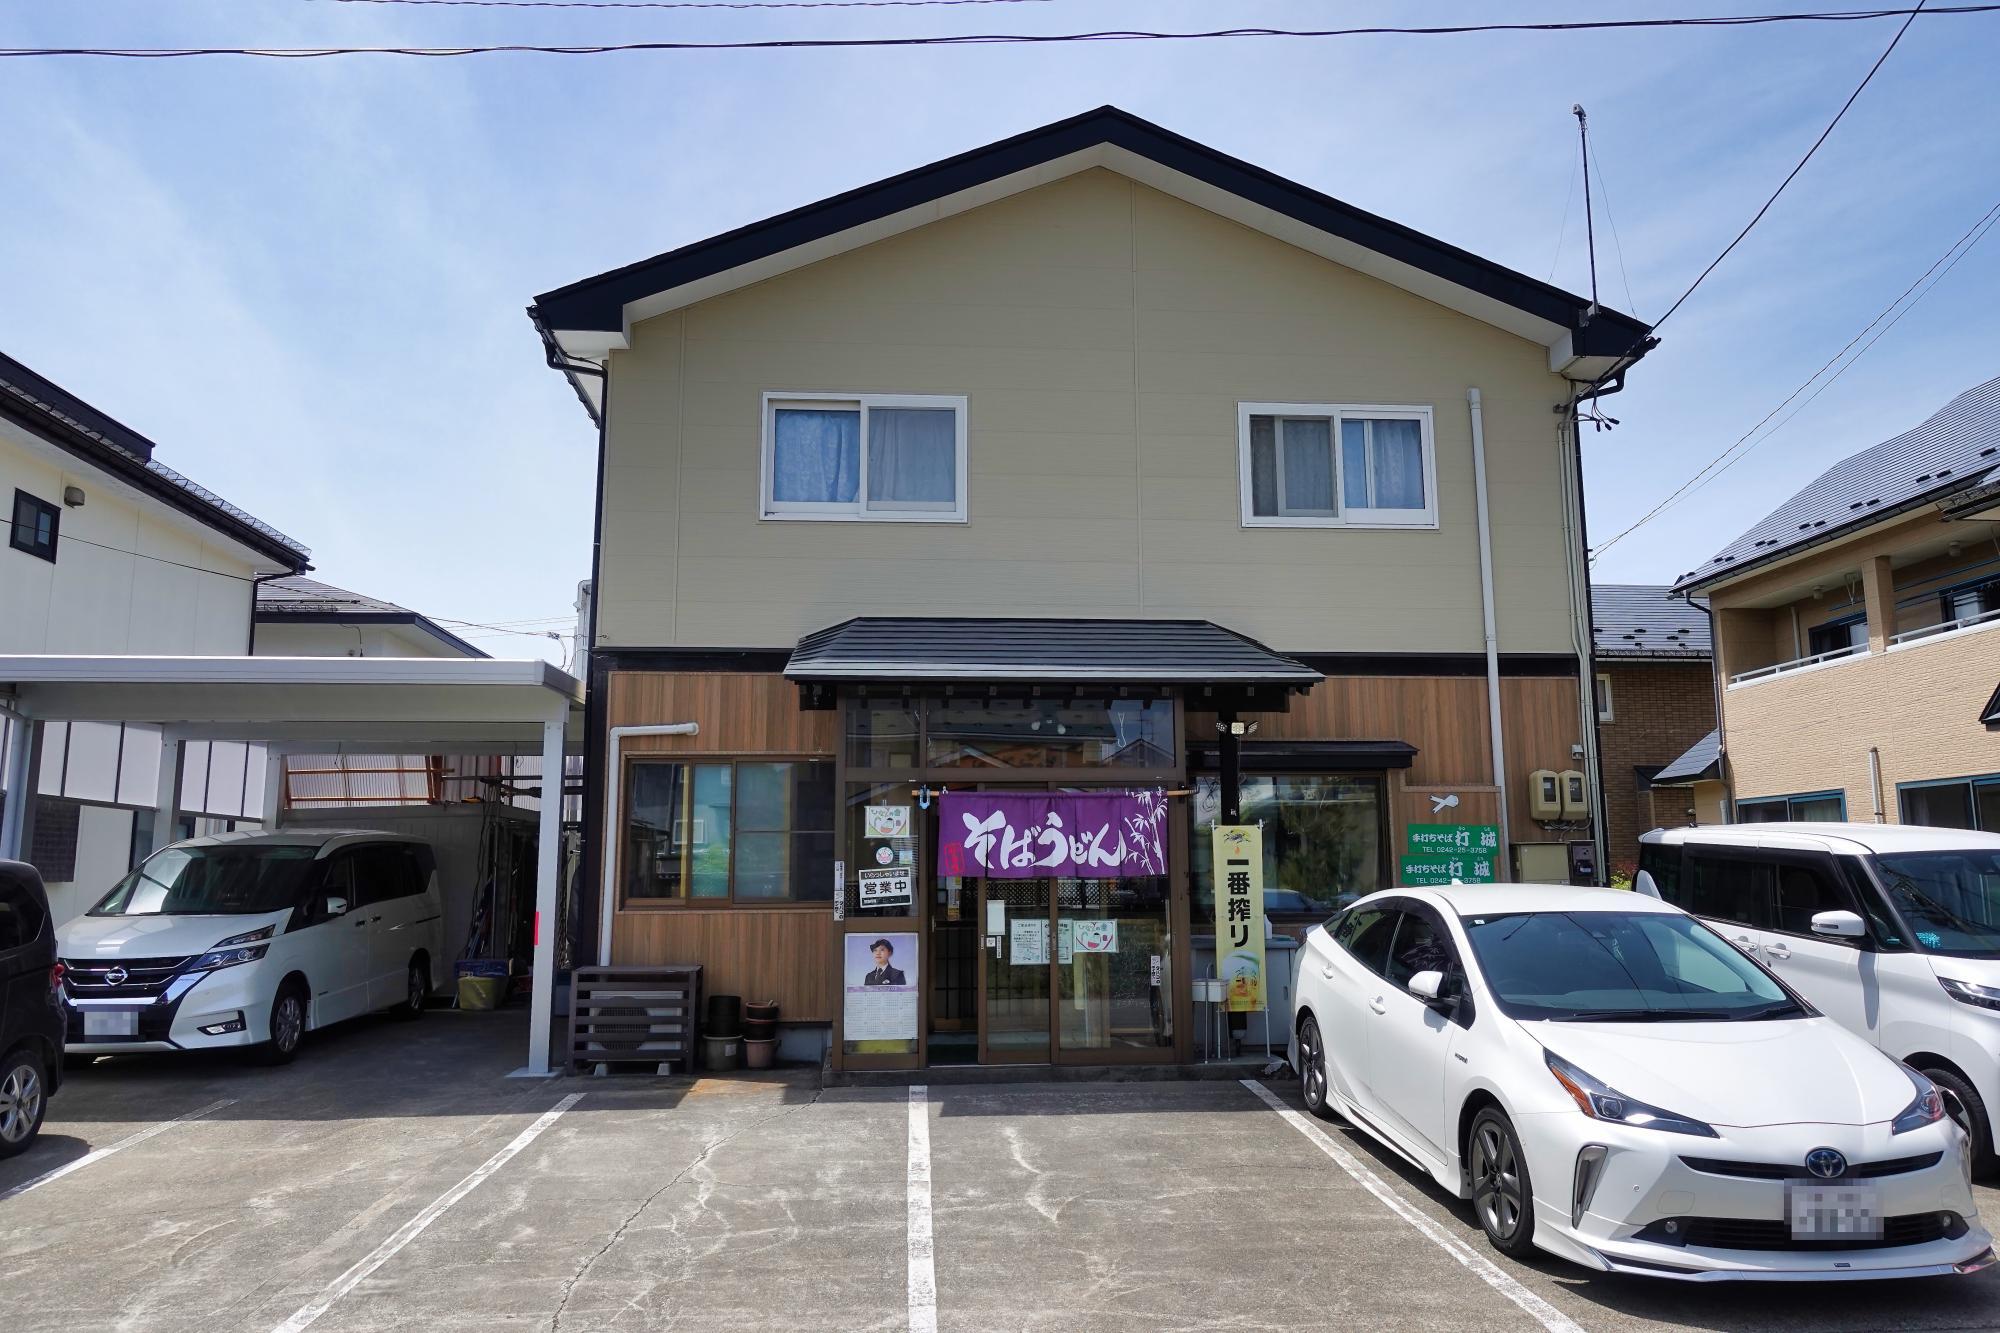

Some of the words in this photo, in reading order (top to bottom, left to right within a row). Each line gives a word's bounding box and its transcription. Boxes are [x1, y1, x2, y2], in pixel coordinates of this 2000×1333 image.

[962, 810, 1127, 869] そばうどん
[1413, 833, 1453, 842] 手打ちそば
[864, 870, 906, 879] いらっしゃいませ
[1406, 864, 1446, 873] 手打ちそば
[864, 880, 907, 895] 営業中
[1226, 859, 1252, 948] 一番搾り
